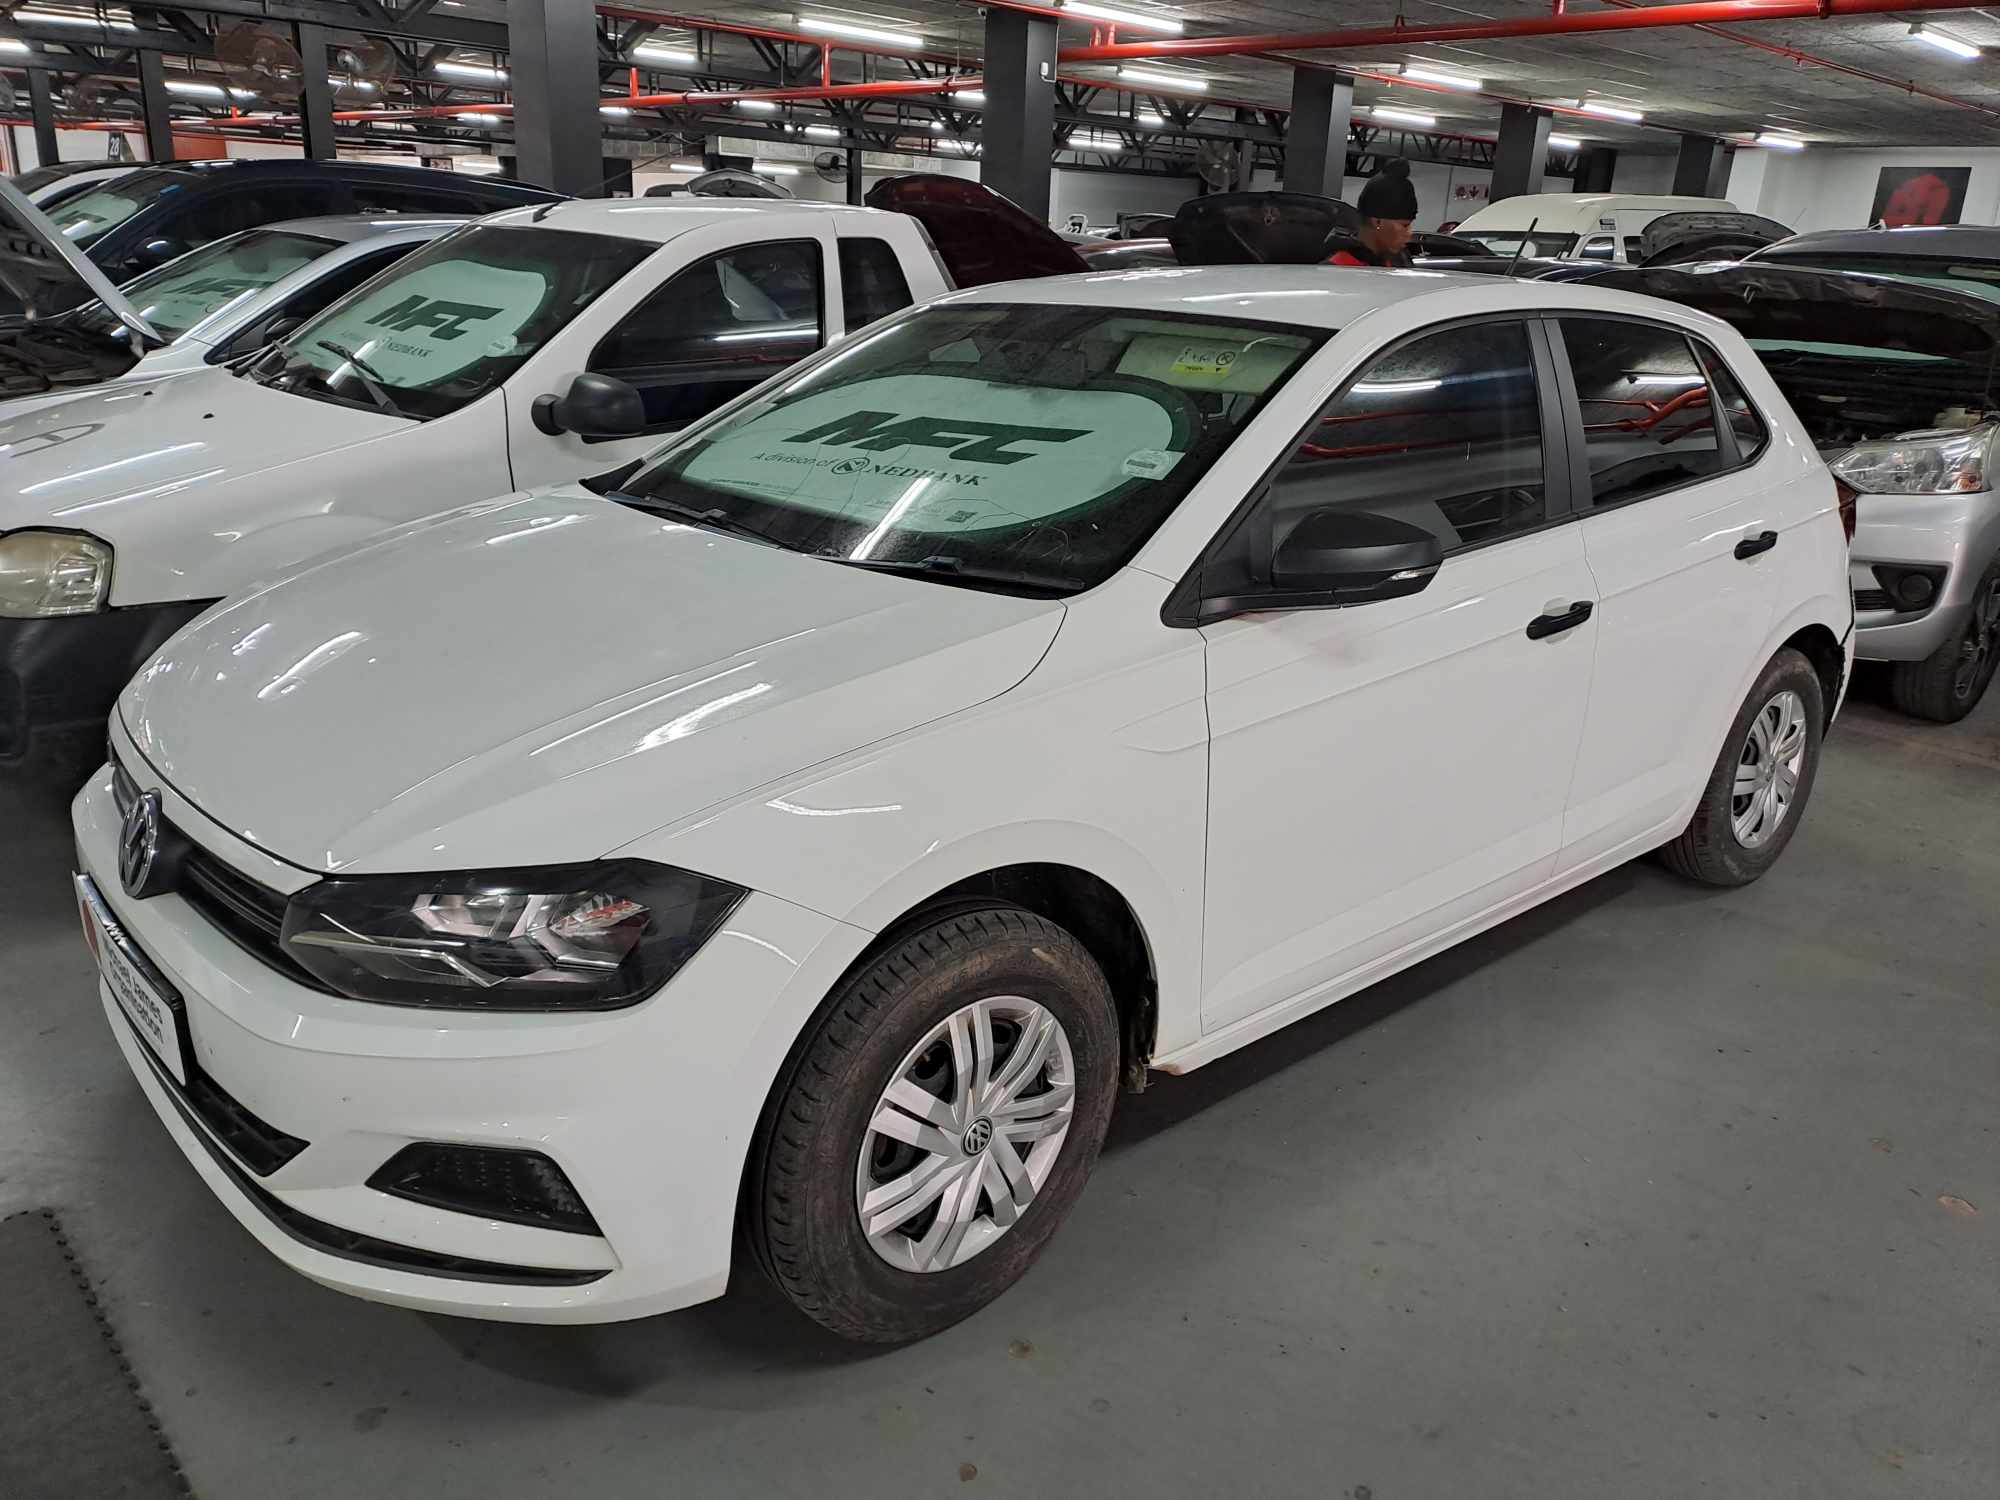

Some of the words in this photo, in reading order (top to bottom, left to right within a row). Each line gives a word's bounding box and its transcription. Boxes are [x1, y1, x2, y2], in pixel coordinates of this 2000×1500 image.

[364, 294, 504, 340] MFC
[782, 410, 1094, 465] MFC
[764, 451, 817, 467] division
[815, 456, 838, 468] of
[866, 464, 986, 486] NEDBANK
